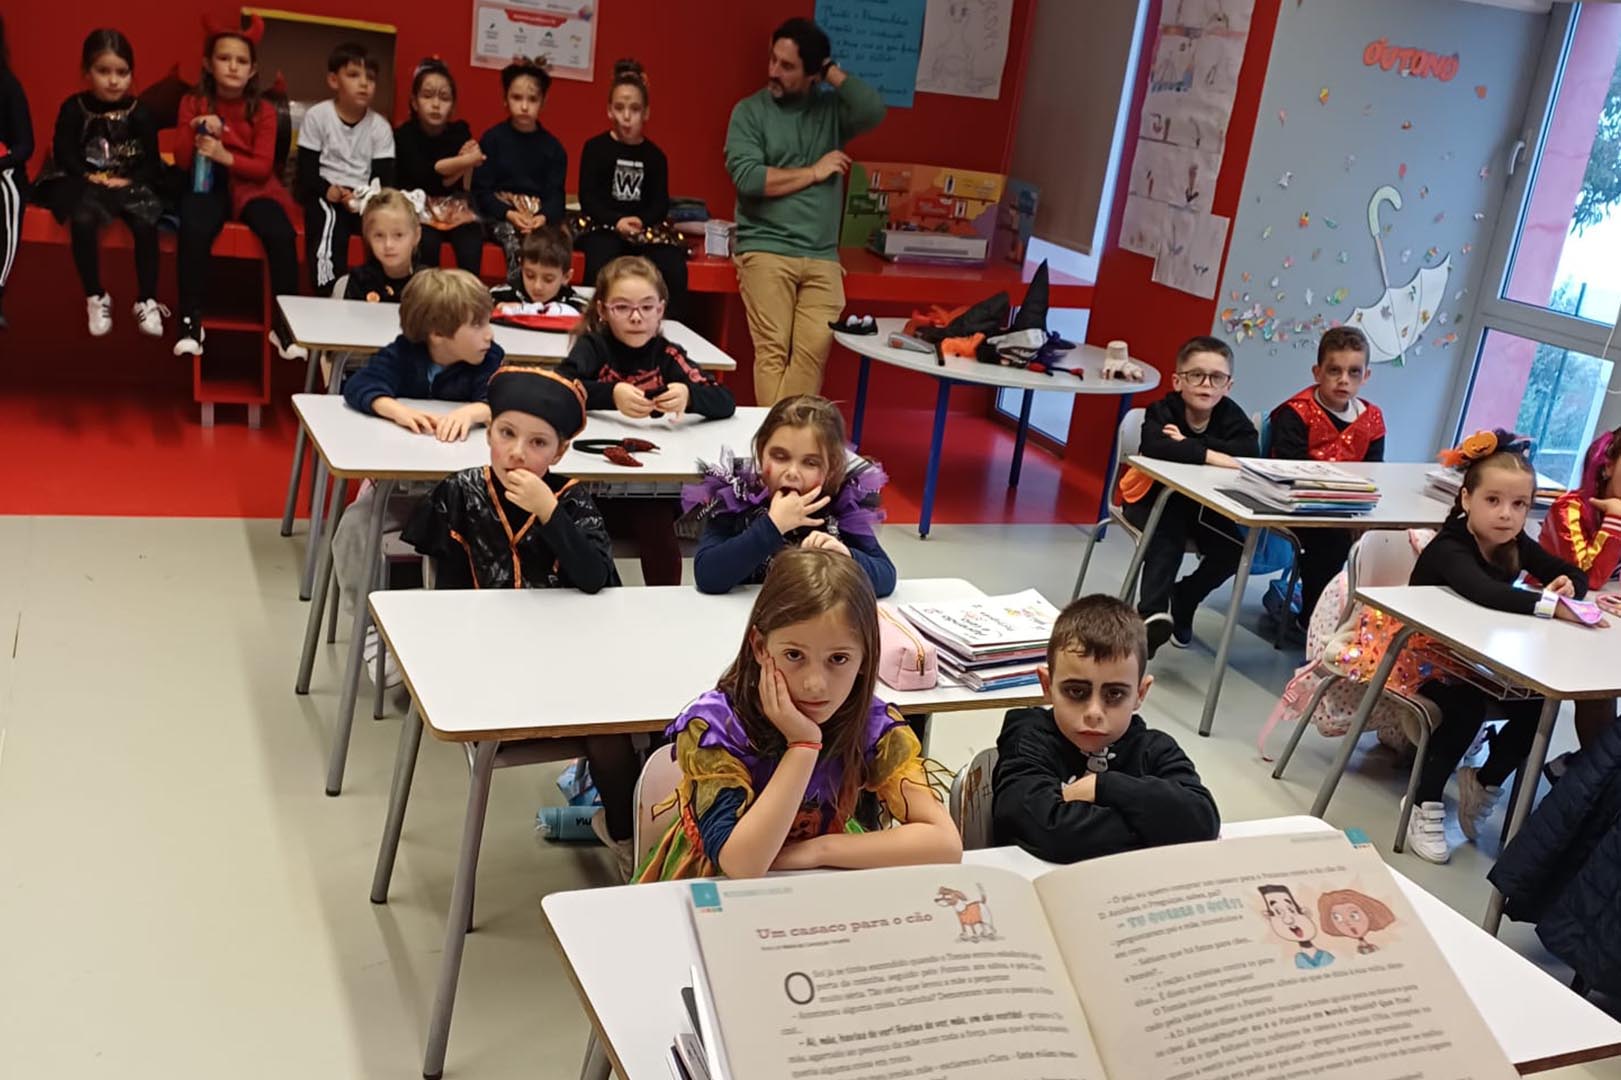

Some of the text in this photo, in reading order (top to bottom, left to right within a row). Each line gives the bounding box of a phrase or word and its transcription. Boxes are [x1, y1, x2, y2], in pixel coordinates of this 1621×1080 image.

[756, 911, 933, 940] Um casaco para o cão
[784, 971, 815, 1005] O
